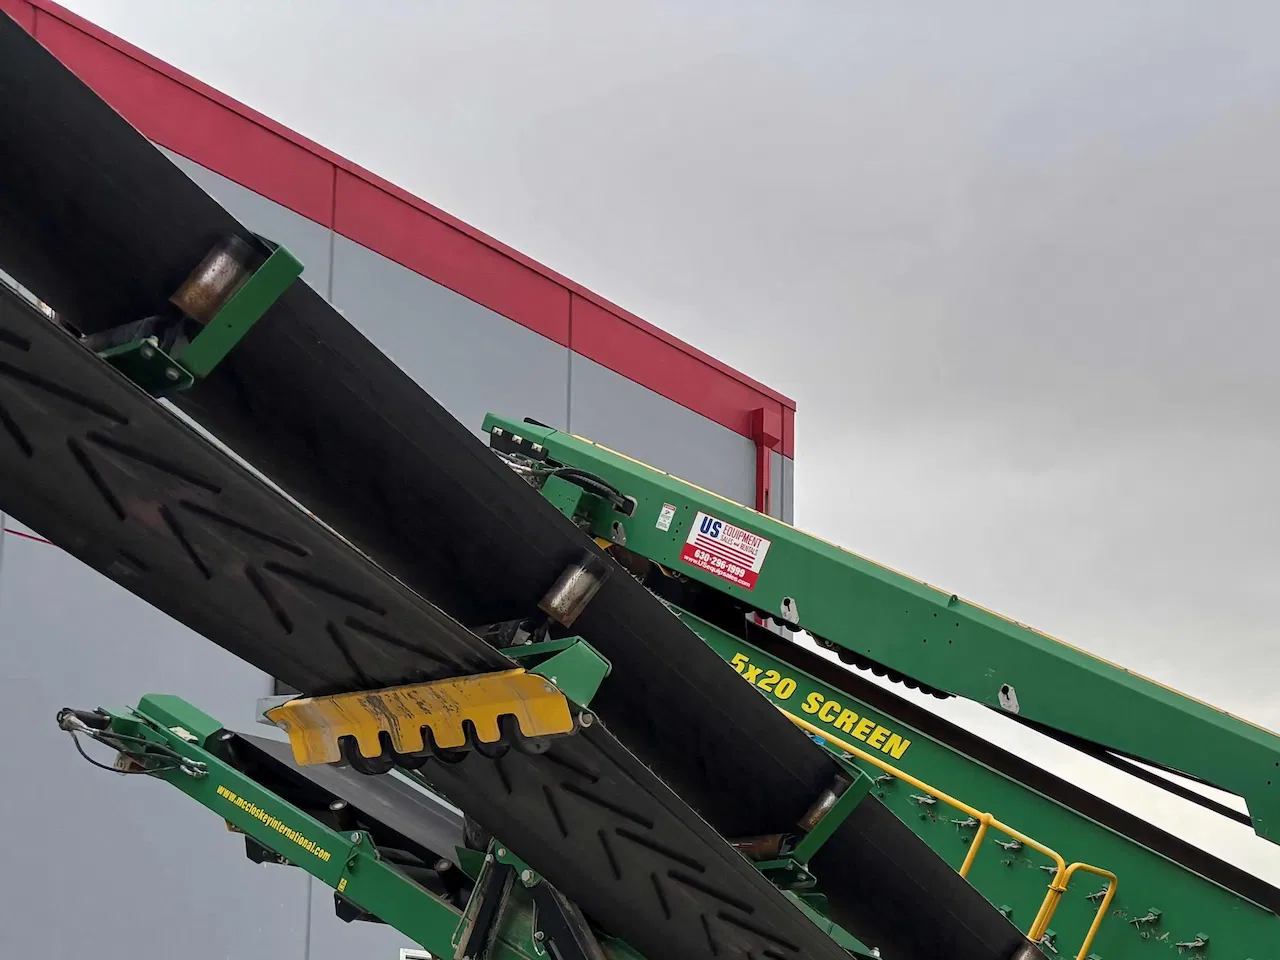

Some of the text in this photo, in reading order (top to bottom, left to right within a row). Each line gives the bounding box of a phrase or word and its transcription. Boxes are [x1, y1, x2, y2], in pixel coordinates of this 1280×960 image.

[699, 516, 722, 538] US
[723, 524, 763, 548] EQUIPMENT
[720, 534, 735, 545] SALES
[739, 542, 759, 556] RENTALS
[683, 555, 751, 588] www.USequipsales.com
[801, 691, 912, 760] SCREEN
[216, 784, 332, 863] www.mccloskeyinternational.com
